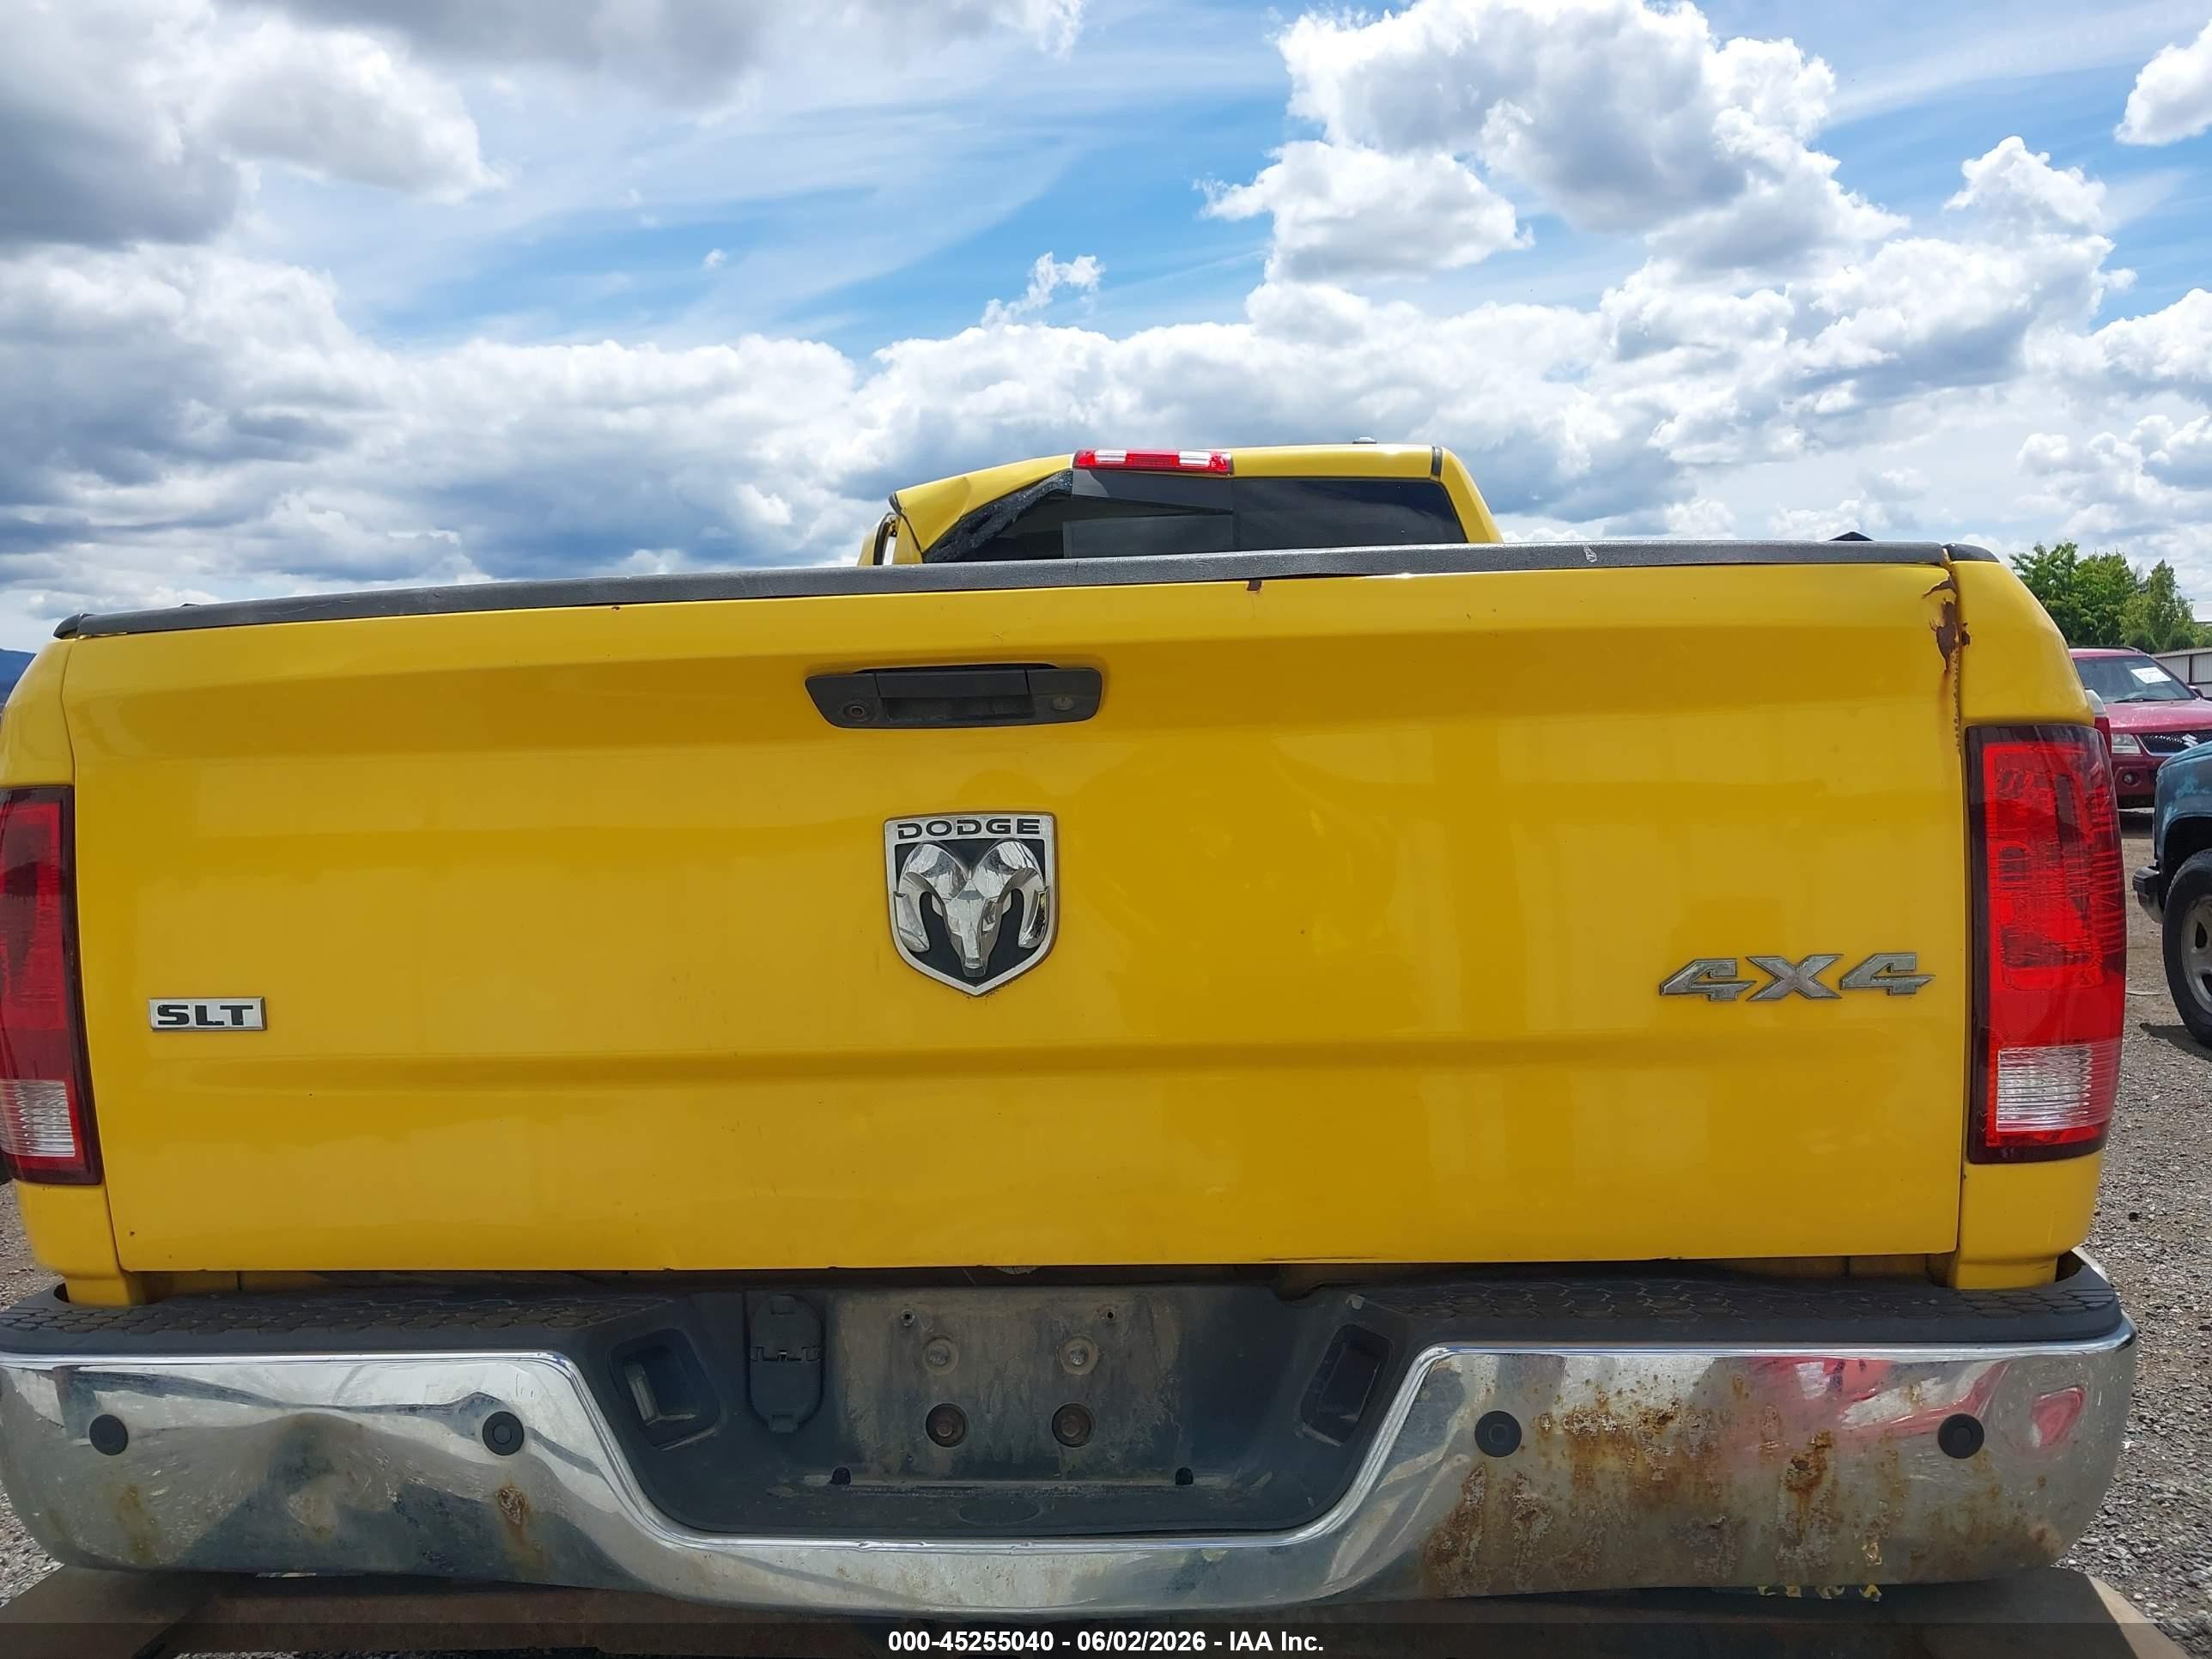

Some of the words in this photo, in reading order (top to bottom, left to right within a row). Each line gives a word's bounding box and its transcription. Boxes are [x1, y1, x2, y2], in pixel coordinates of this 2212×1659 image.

[897, 818, 1041, 840] DODGE
[1659, 952, 1936, 1002] 4X4
[157, 1004, 254, 1026] SLT
